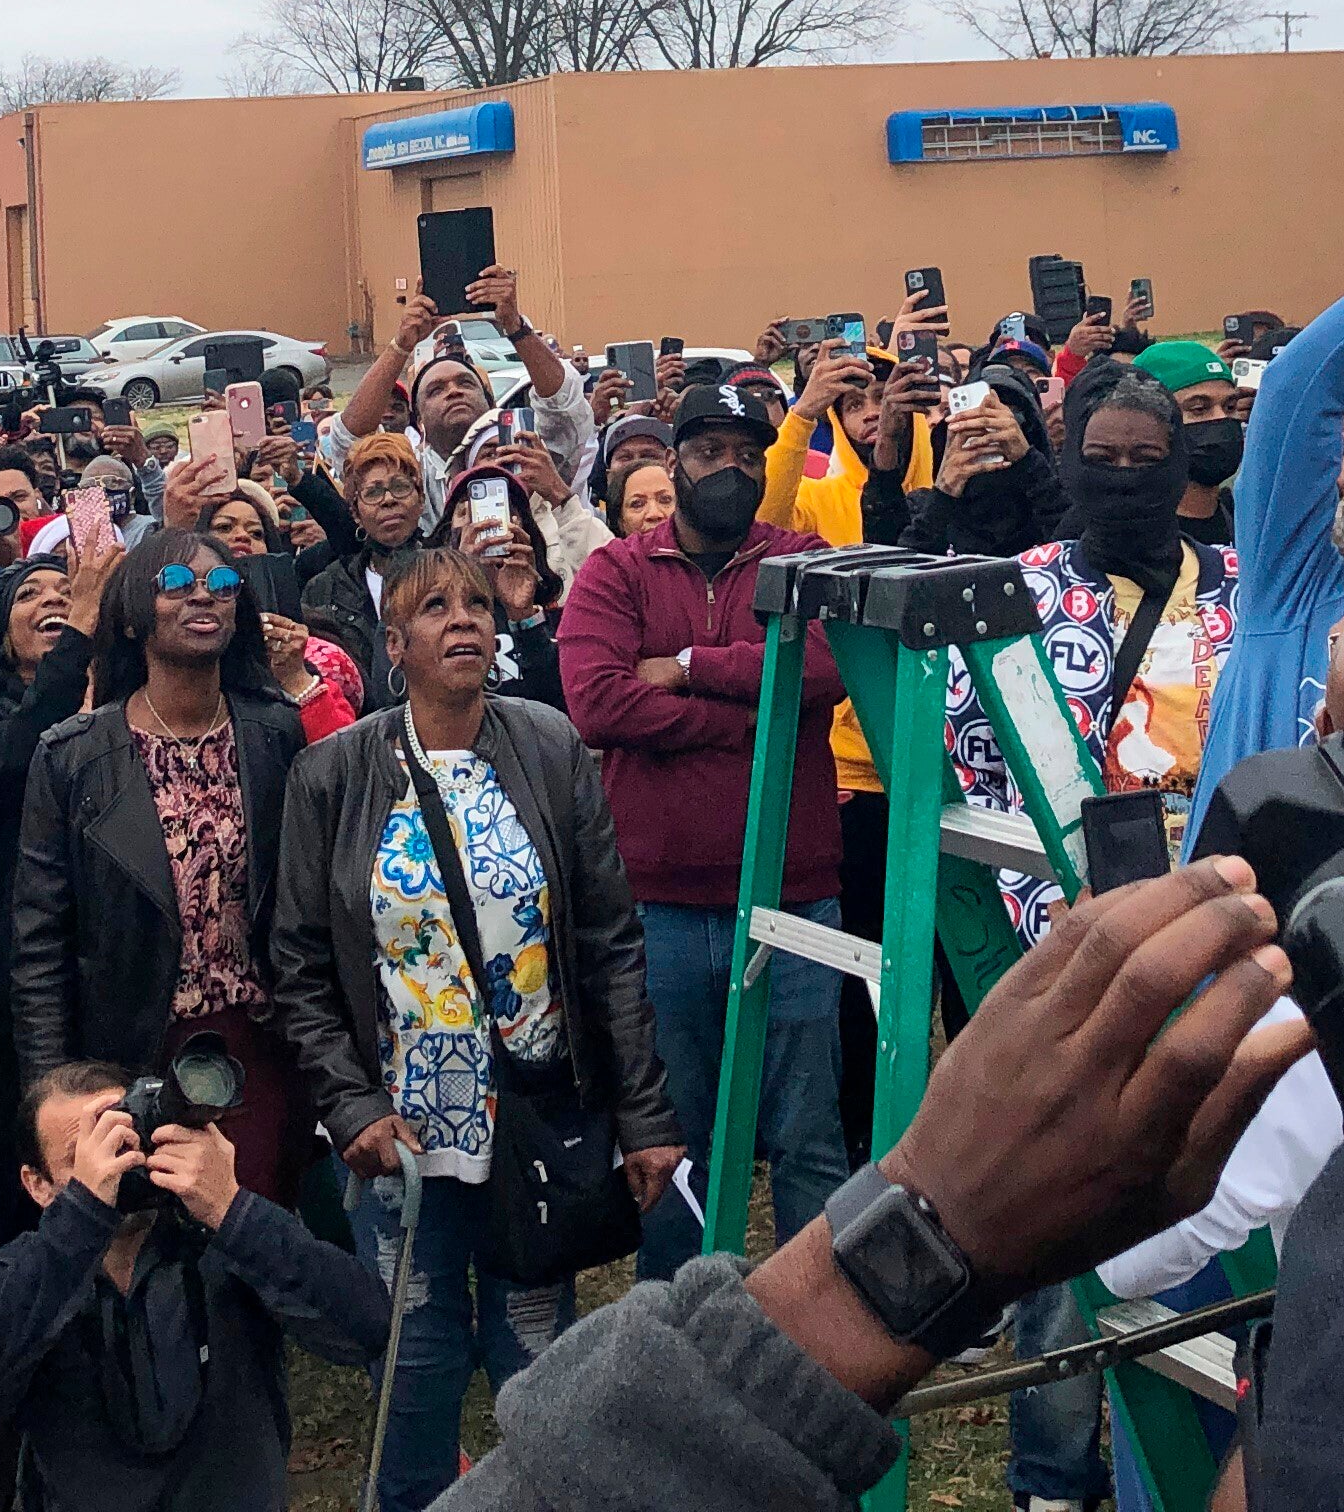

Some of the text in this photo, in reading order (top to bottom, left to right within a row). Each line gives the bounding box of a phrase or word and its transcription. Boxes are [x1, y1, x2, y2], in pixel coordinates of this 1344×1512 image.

[1133, 129, 1160, 144] INC.
[1071, 589, 1090, 617] B
[1203, 609, 1227, 639] B
[1049, 639, 1101, 673] FLY
[967, 734, 1004, 763] FL
